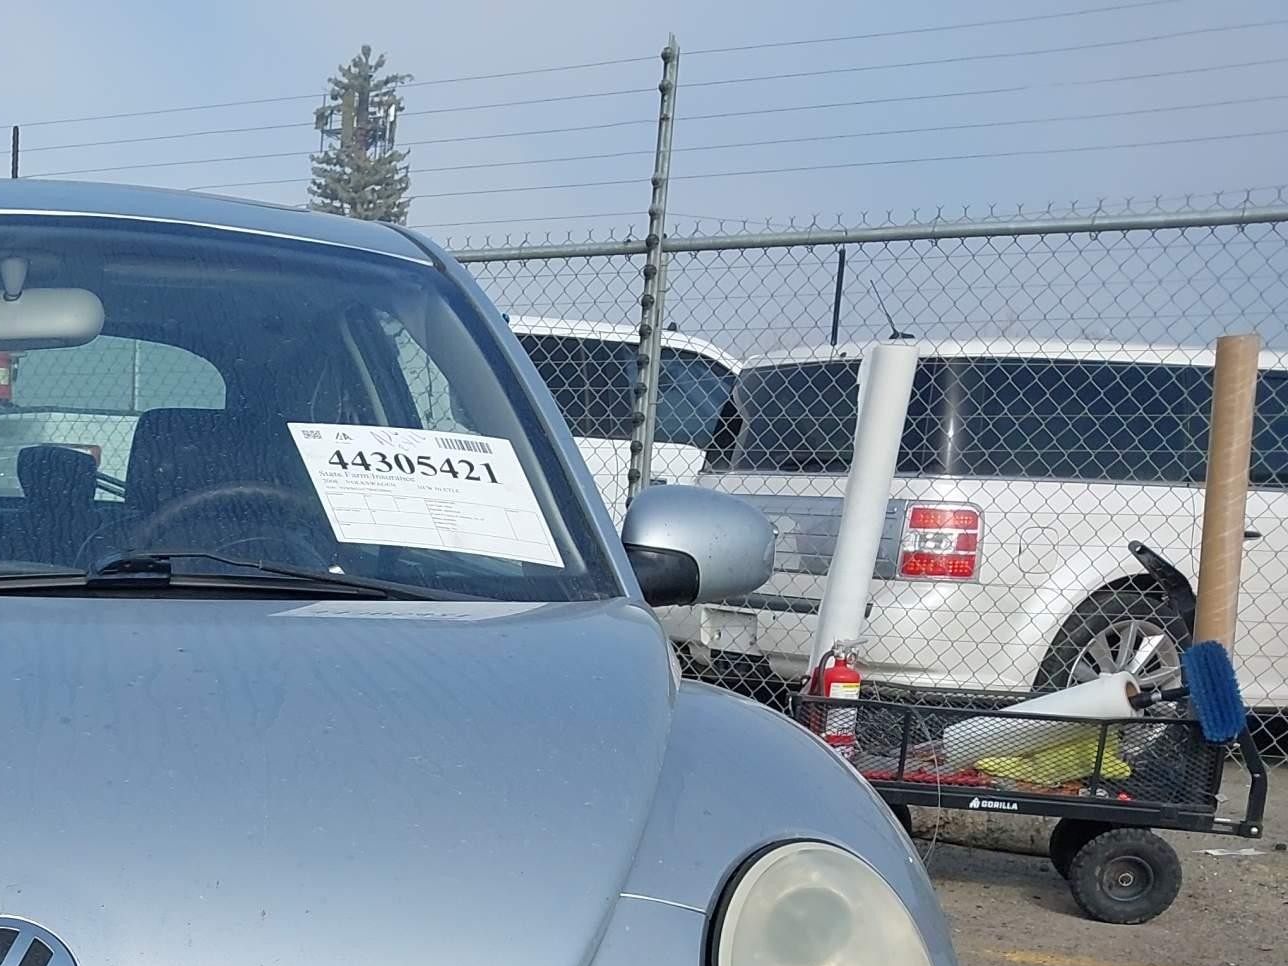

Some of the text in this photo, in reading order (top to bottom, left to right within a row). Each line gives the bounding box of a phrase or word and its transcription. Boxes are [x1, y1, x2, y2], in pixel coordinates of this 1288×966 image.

[328, 449, 502, 485] 44305421
[344, 471, 369, 479] Farm
[981, 800, 1018, 810] GORILLA
